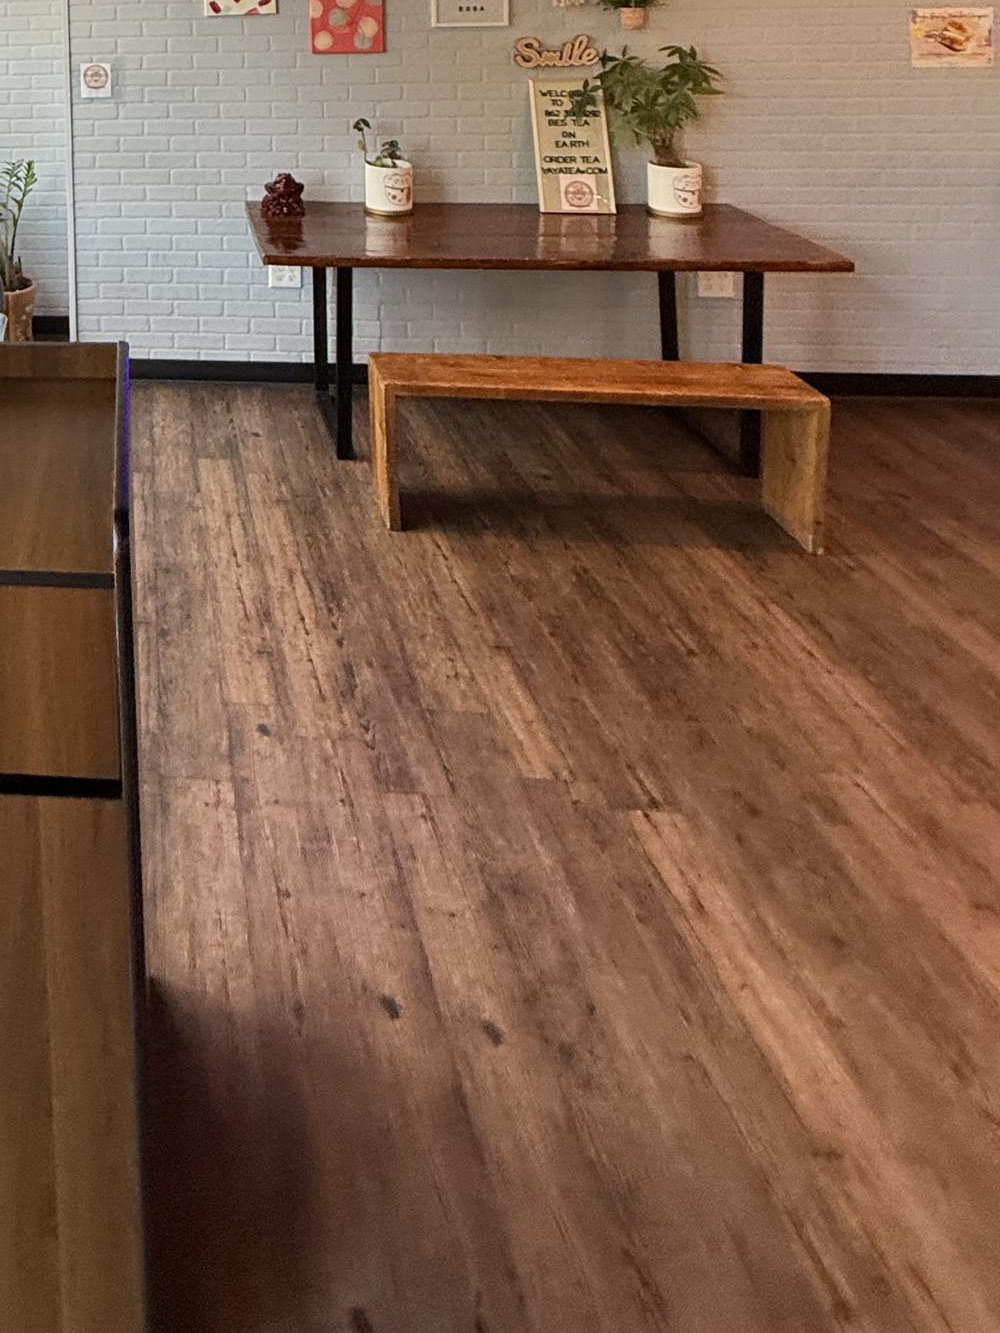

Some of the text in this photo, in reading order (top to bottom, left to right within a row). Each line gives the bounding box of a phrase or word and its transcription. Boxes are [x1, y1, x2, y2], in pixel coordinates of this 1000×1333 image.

[514, 34, 599, 68] Smile
[551, 99, 564, 107] TO
[561, 131, 576, 139] ON
[554, 140, 590, 148] EARTH
[543, 155, 600, 164] ORDER TEA
